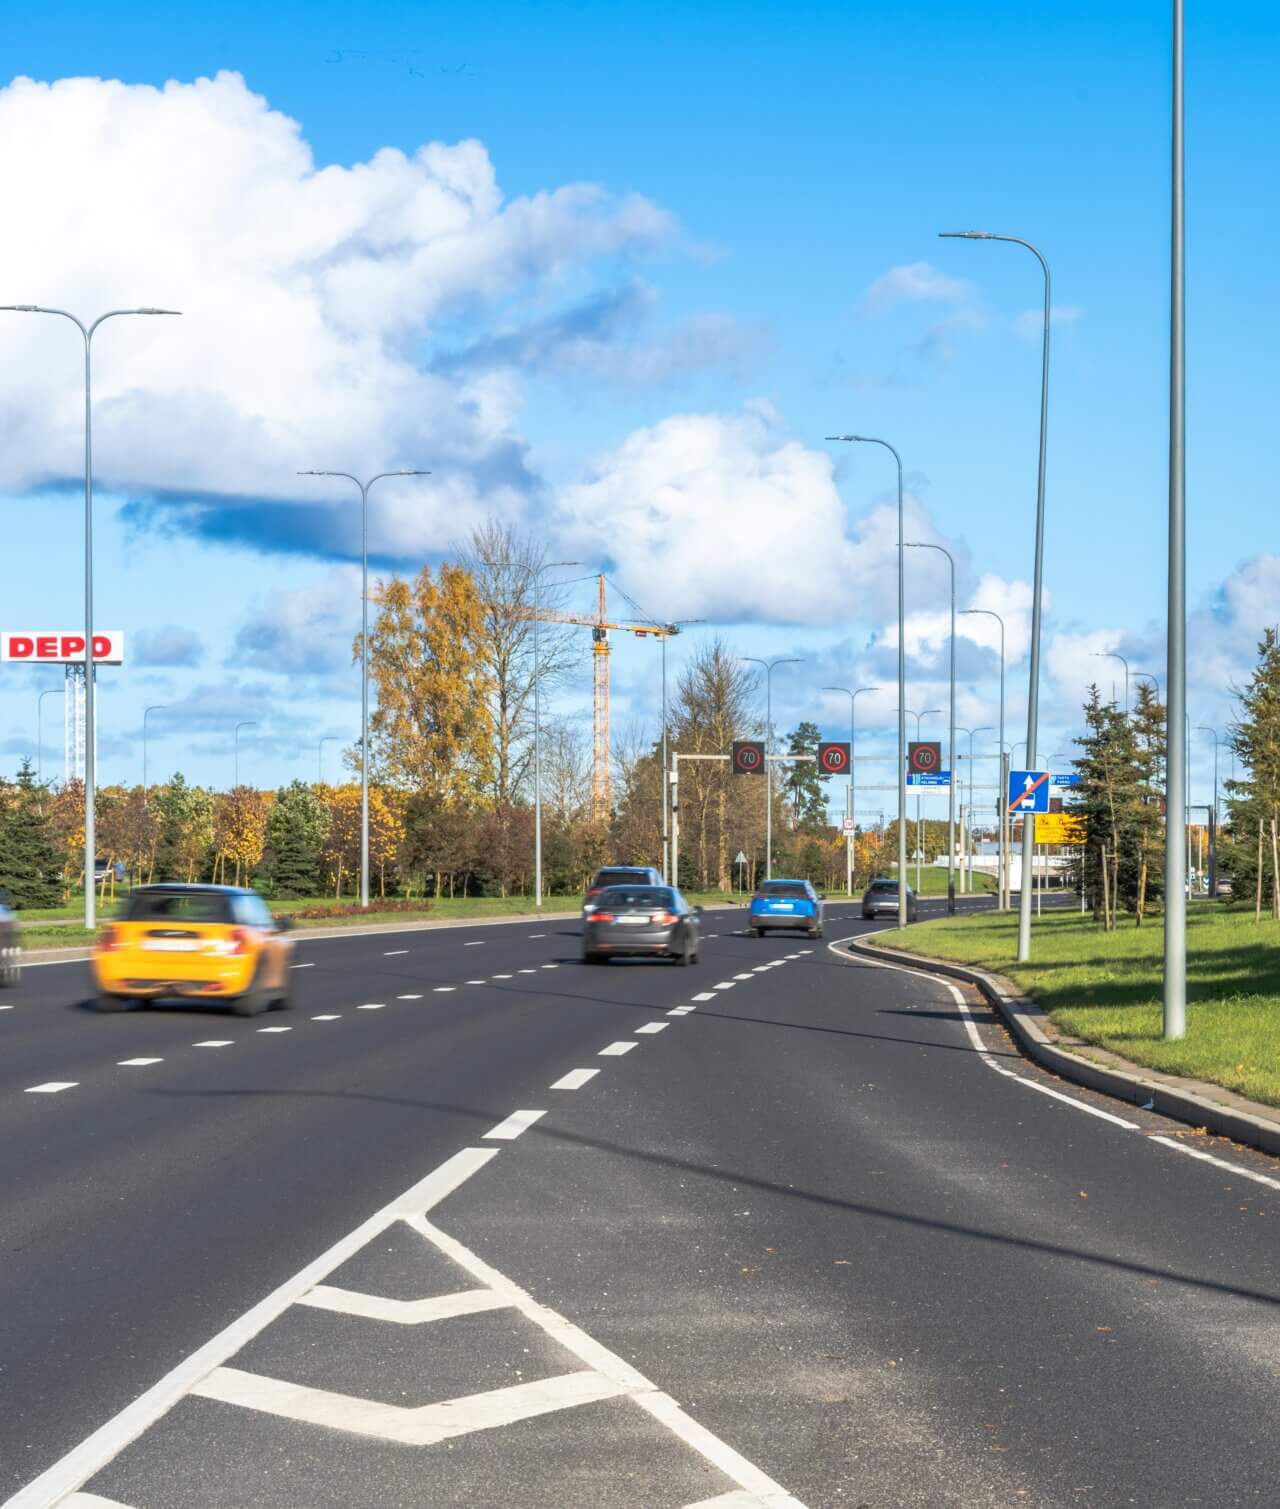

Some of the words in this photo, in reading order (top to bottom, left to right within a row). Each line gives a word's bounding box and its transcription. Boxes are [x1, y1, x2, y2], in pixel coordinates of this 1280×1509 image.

[9, 636, 112, 658] DEPO
[742, 752, 756, 764] 70
[828, 752, 841, 764] 70
[919, 752, 931, 764] 70
